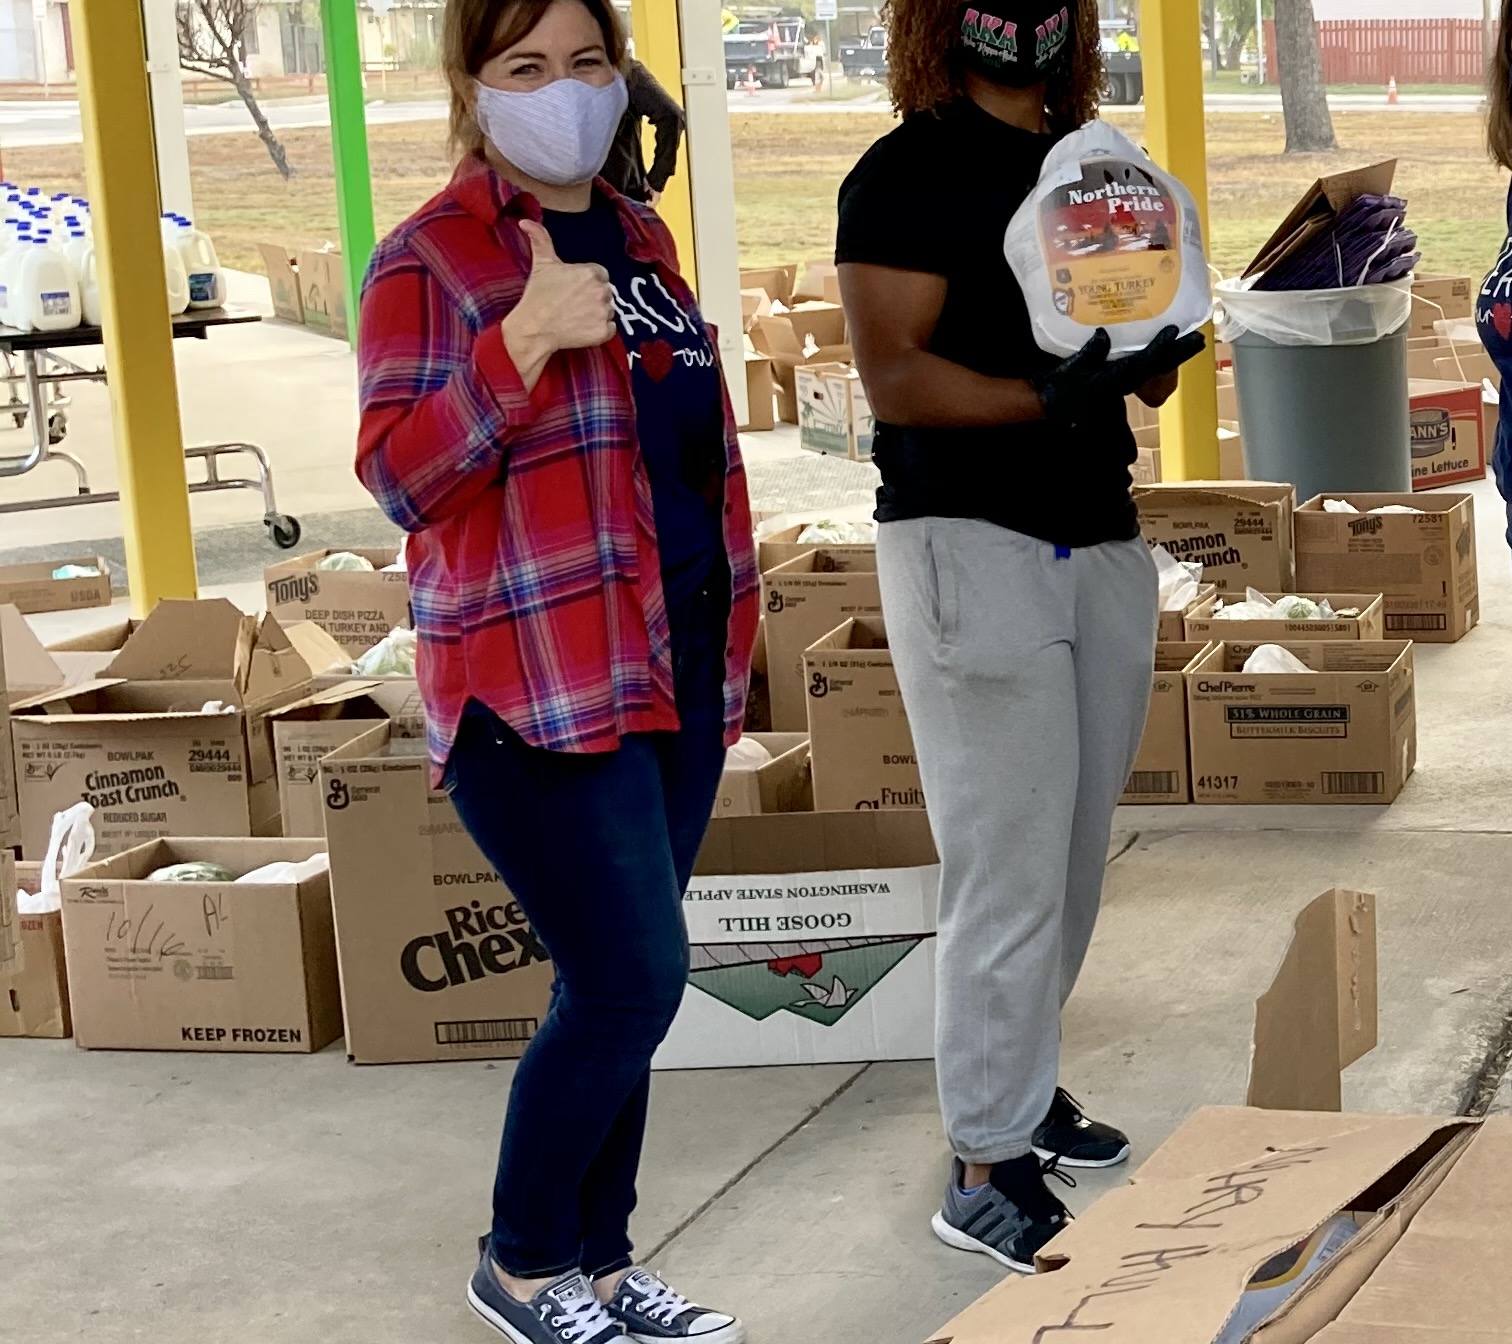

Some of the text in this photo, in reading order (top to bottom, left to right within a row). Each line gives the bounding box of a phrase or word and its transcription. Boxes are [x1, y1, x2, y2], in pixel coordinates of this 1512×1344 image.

[1068, 181, 1161, 206] Northern
[1107, 196, 1165, 214] Pride
[1431, 458, 1469, 474] Lettuce
[1234, 517, 1264, 527] 29444
[1348, 516, 1383, 536] Tony's
[1412, 514, 1443, 524] 72581
[268, 572, 320, 603] Tony's
[305, 609, 385, 621] DEEP DISH PIZZA
[329, 623, 390, 634] TURKEY AND
[1232, 708, 1342, 719] 51% WHOLE GRAIN
[107, 751, 155, 762] BOWLPAK
[188, 748, 231, 762] 29444
[85, 765, 165, 791] Cinnamon
[1197, 775, 1239, 789] 41317
[125, 780, 180, 803] Crunch
[736, 888, 784, 900] STATE
[787, 882, 891, 899] WASHINGTON
[444, 899, 528, 942] Rice
[718, 912, 852, 933] GOOSE HILL
[400, 927, 552, 993] Chex
[181, 1027, 302, 1043] KEEP FROZEN
